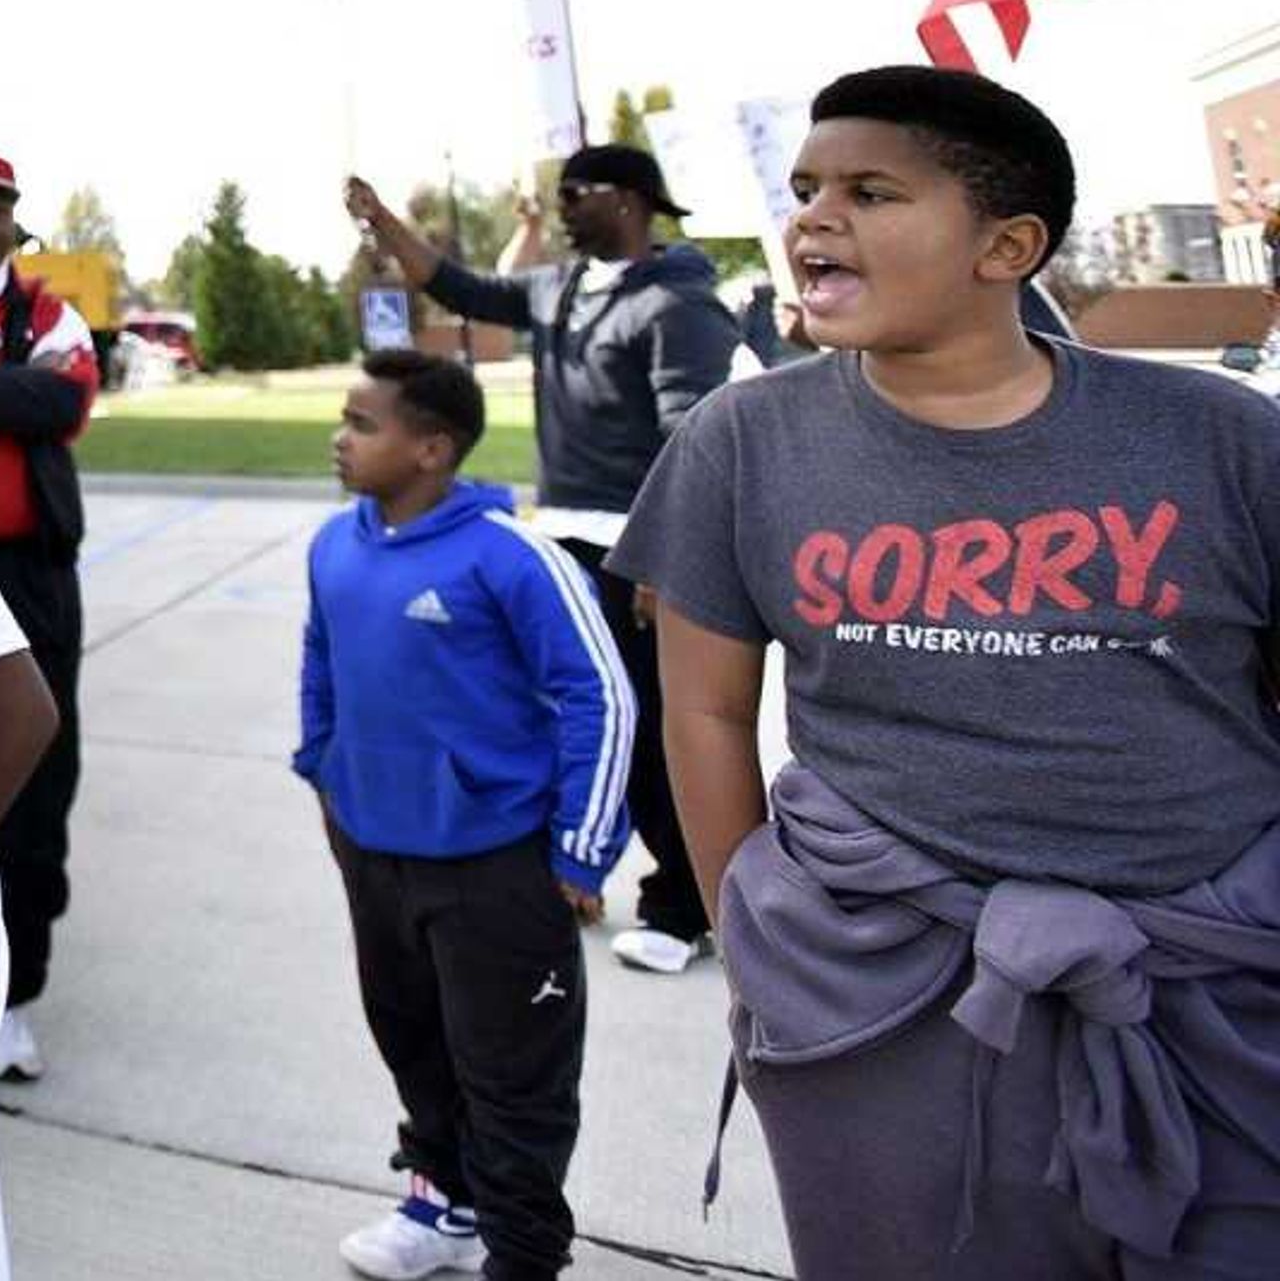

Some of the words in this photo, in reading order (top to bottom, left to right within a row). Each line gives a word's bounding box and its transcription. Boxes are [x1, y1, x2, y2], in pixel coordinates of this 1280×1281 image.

[794, 500, 1182, 624] SORRY,
[836, 622, 877, 644] NOT
[885, 622, 1046, 658] EVERYONE
[1049, 633, 1101, 655] CAN
